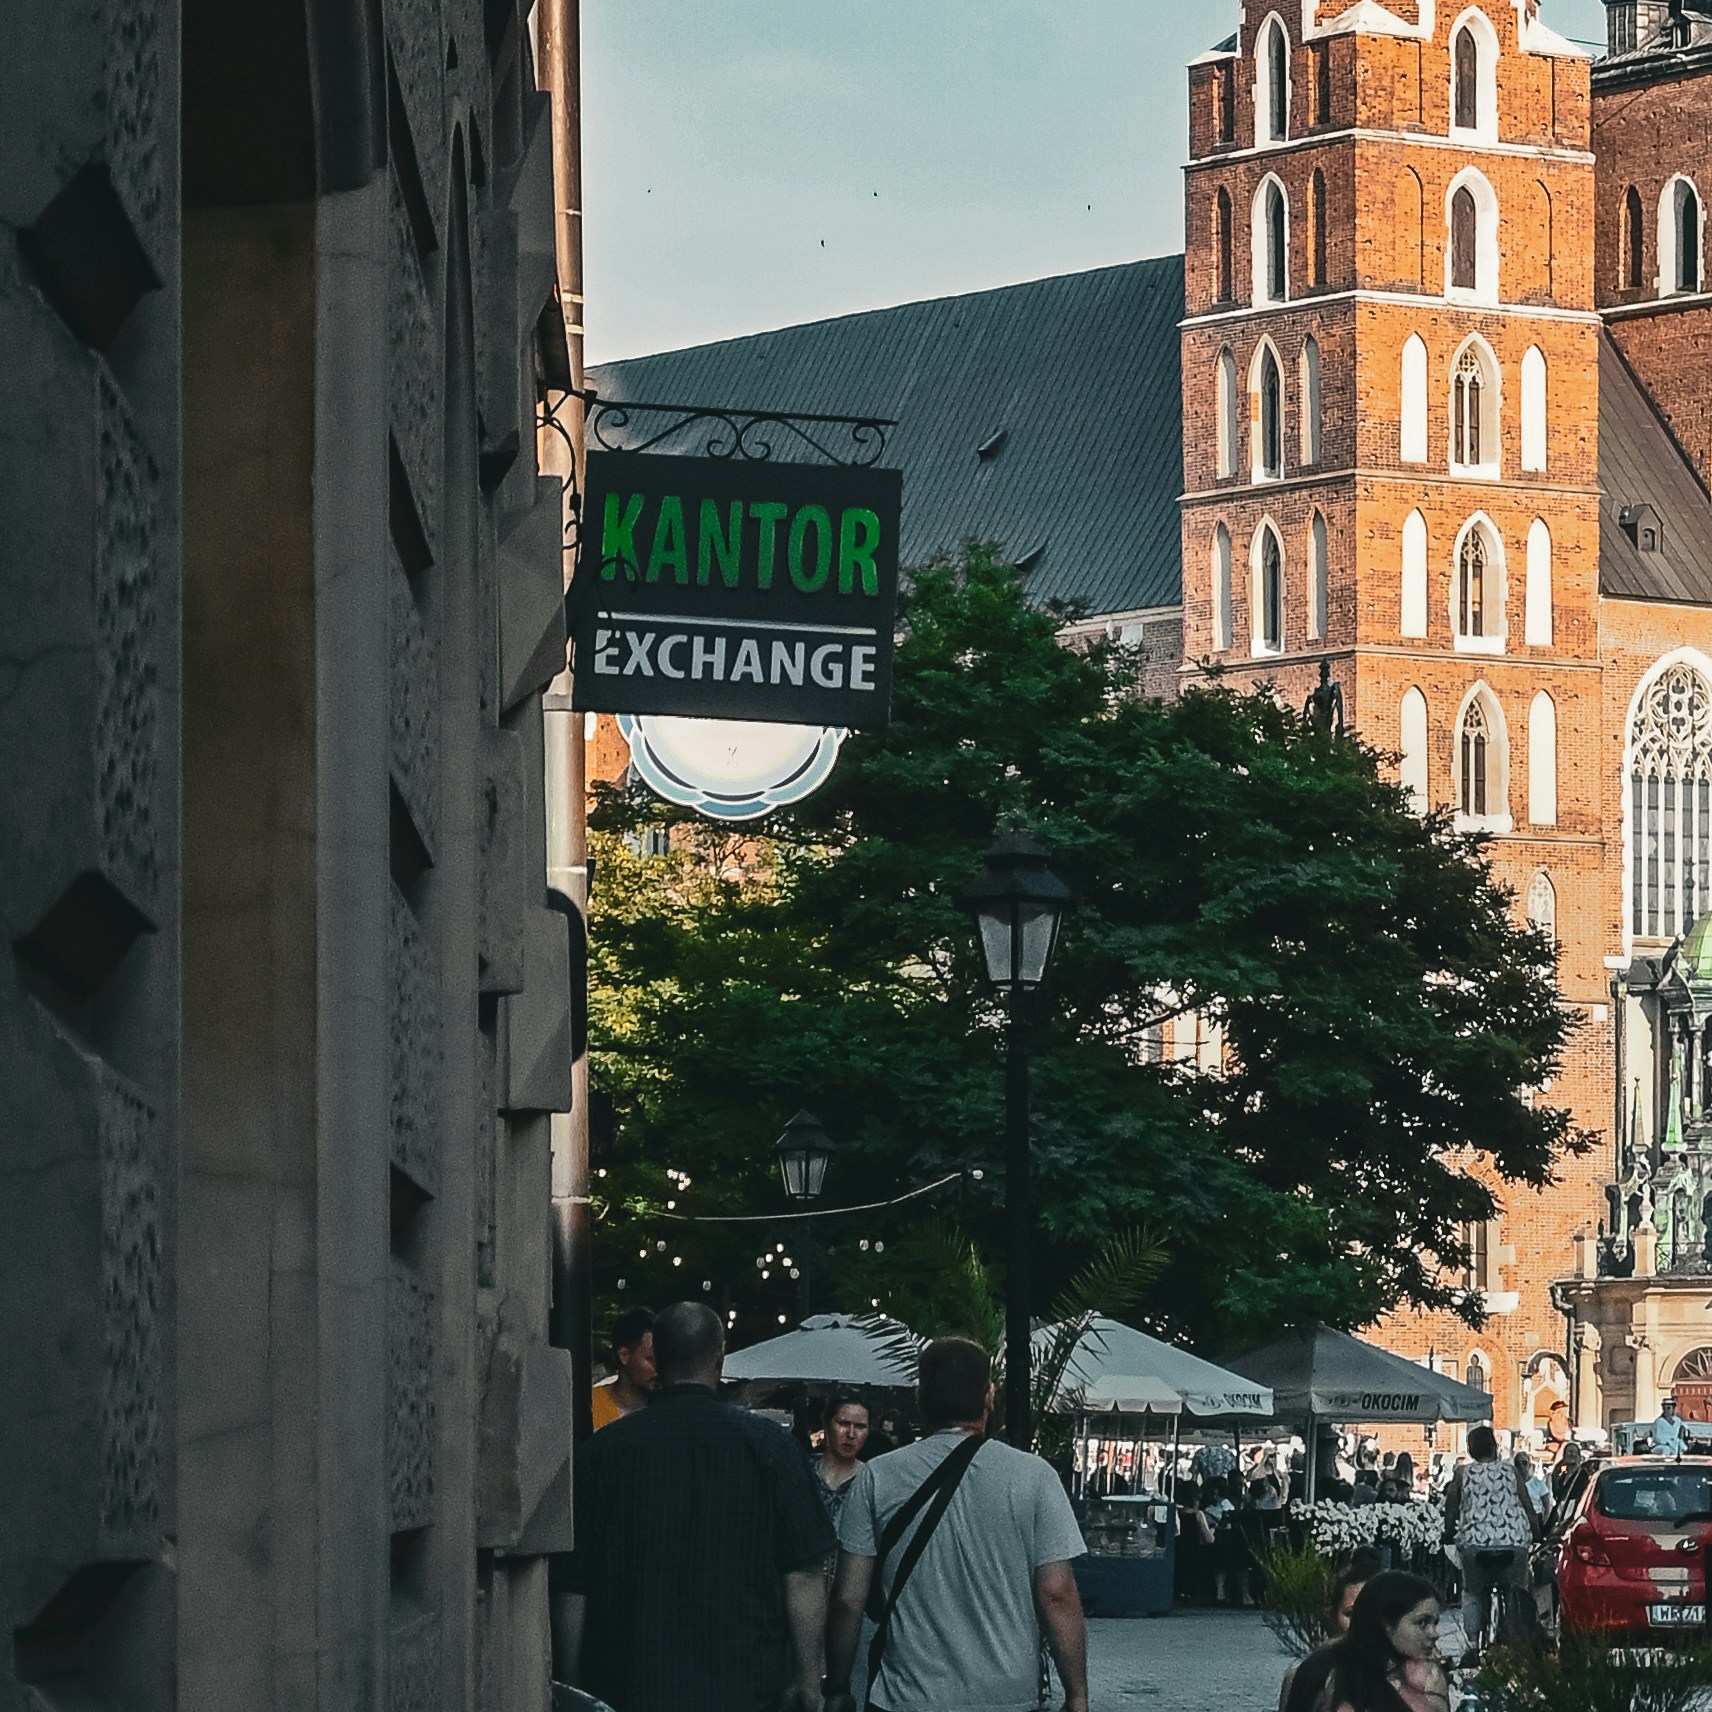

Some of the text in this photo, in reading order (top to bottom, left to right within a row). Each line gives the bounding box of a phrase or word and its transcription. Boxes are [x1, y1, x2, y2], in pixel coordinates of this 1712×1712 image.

[600, 492, 881, 597] KANTOR
[593, 629, 877, 691] EXCHANGE
[1361, 1392, 1420, 1411] OKOCIM
